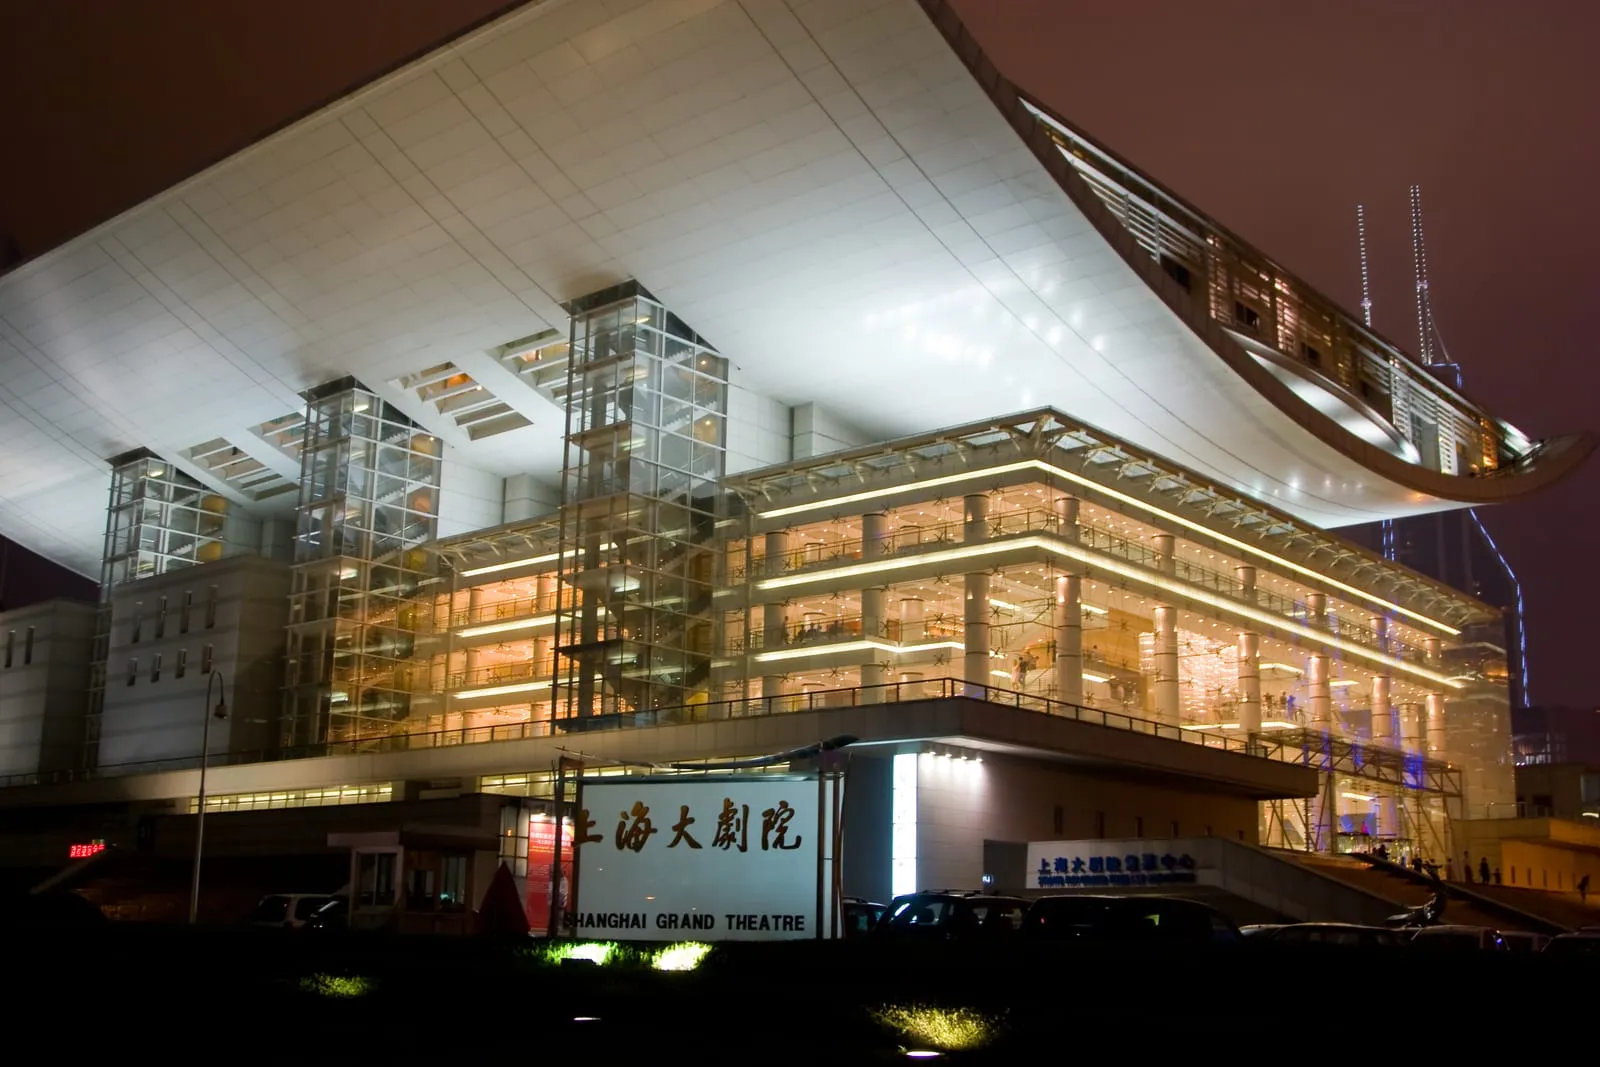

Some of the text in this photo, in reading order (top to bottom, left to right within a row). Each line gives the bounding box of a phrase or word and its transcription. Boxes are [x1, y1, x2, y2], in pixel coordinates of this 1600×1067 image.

[572, 797, 802, 853] 上海大劇院
[563, 912, 805, 931] SHANGHAI GRAND THEATRE
